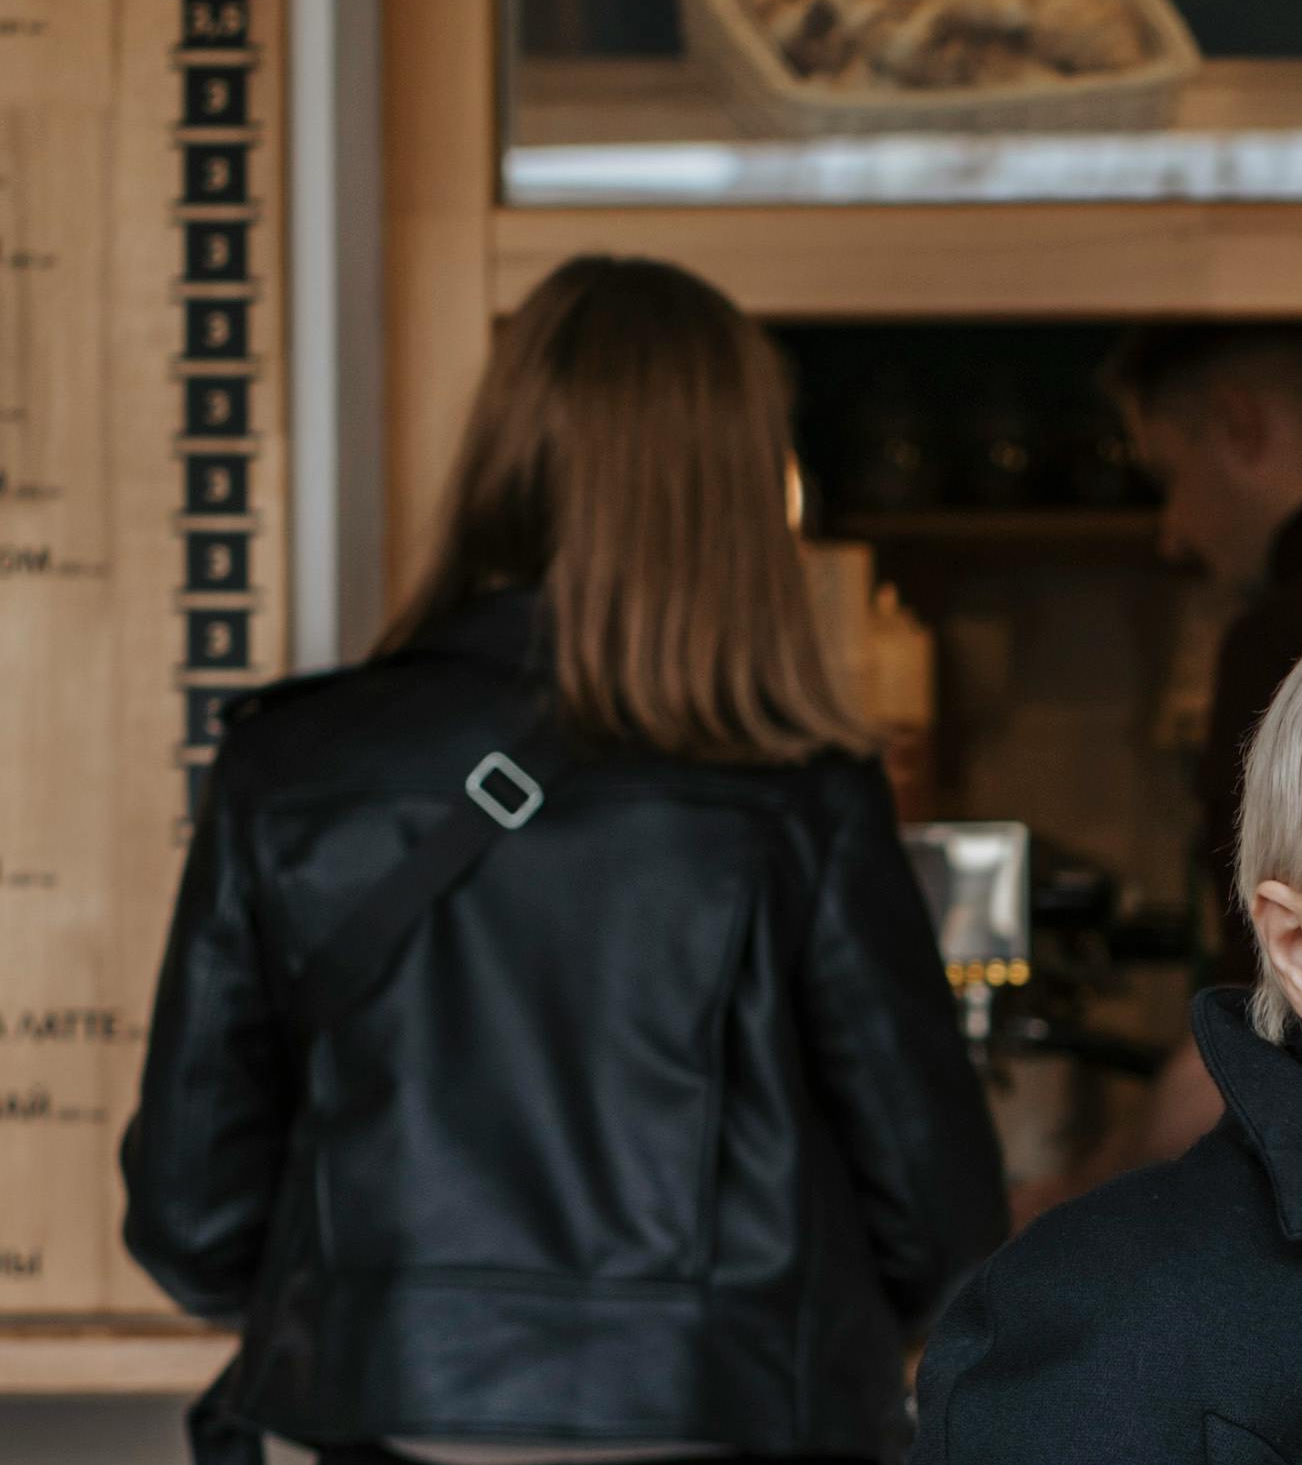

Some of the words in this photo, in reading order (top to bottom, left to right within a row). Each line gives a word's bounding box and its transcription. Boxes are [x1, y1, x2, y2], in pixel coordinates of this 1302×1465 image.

[206, 82, 228, 113] 3
[206, 160, 228, 191] 3
[206, 237, 228, 269] 3
[206, 316, 228, 347] 3
[207, 393, 229, 424] 3
[207, 470, 229, 501] 3
[207, 548, 229, 579] 3
[208, 625, 230, 656] 3
[18, 1010, 121, 1043] ЛАТТЕ
